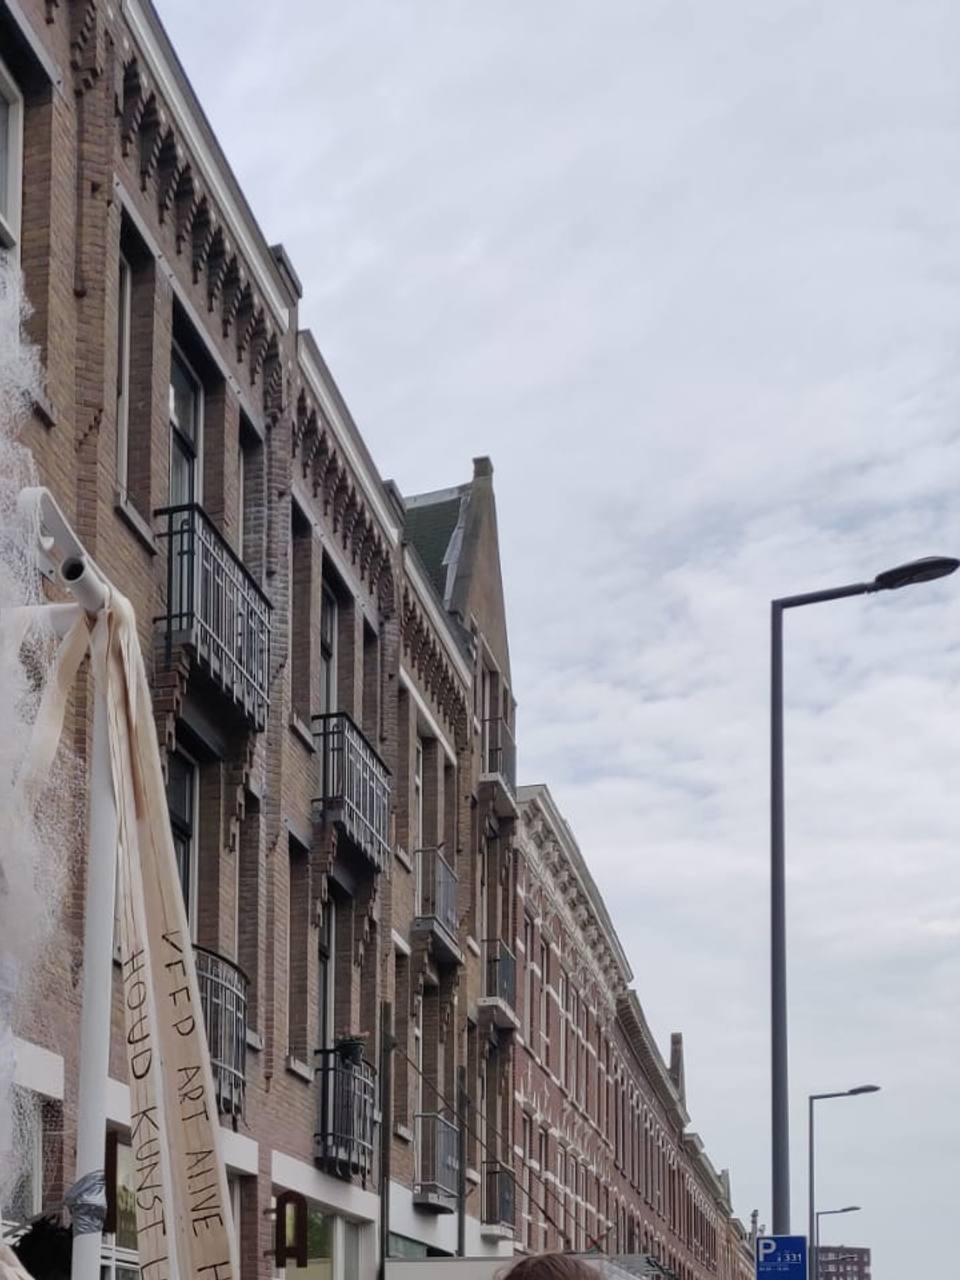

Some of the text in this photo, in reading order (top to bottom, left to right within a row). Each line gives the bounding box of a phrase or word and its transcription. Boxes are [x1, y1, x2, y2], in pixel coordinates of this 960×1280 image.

[124, 949, 152, 1080] HOUD
[177, 1065, 210, 1122] ART
[131, 1106, 167, 1237] KUNST
[758, 1239, 776, 1262] P
